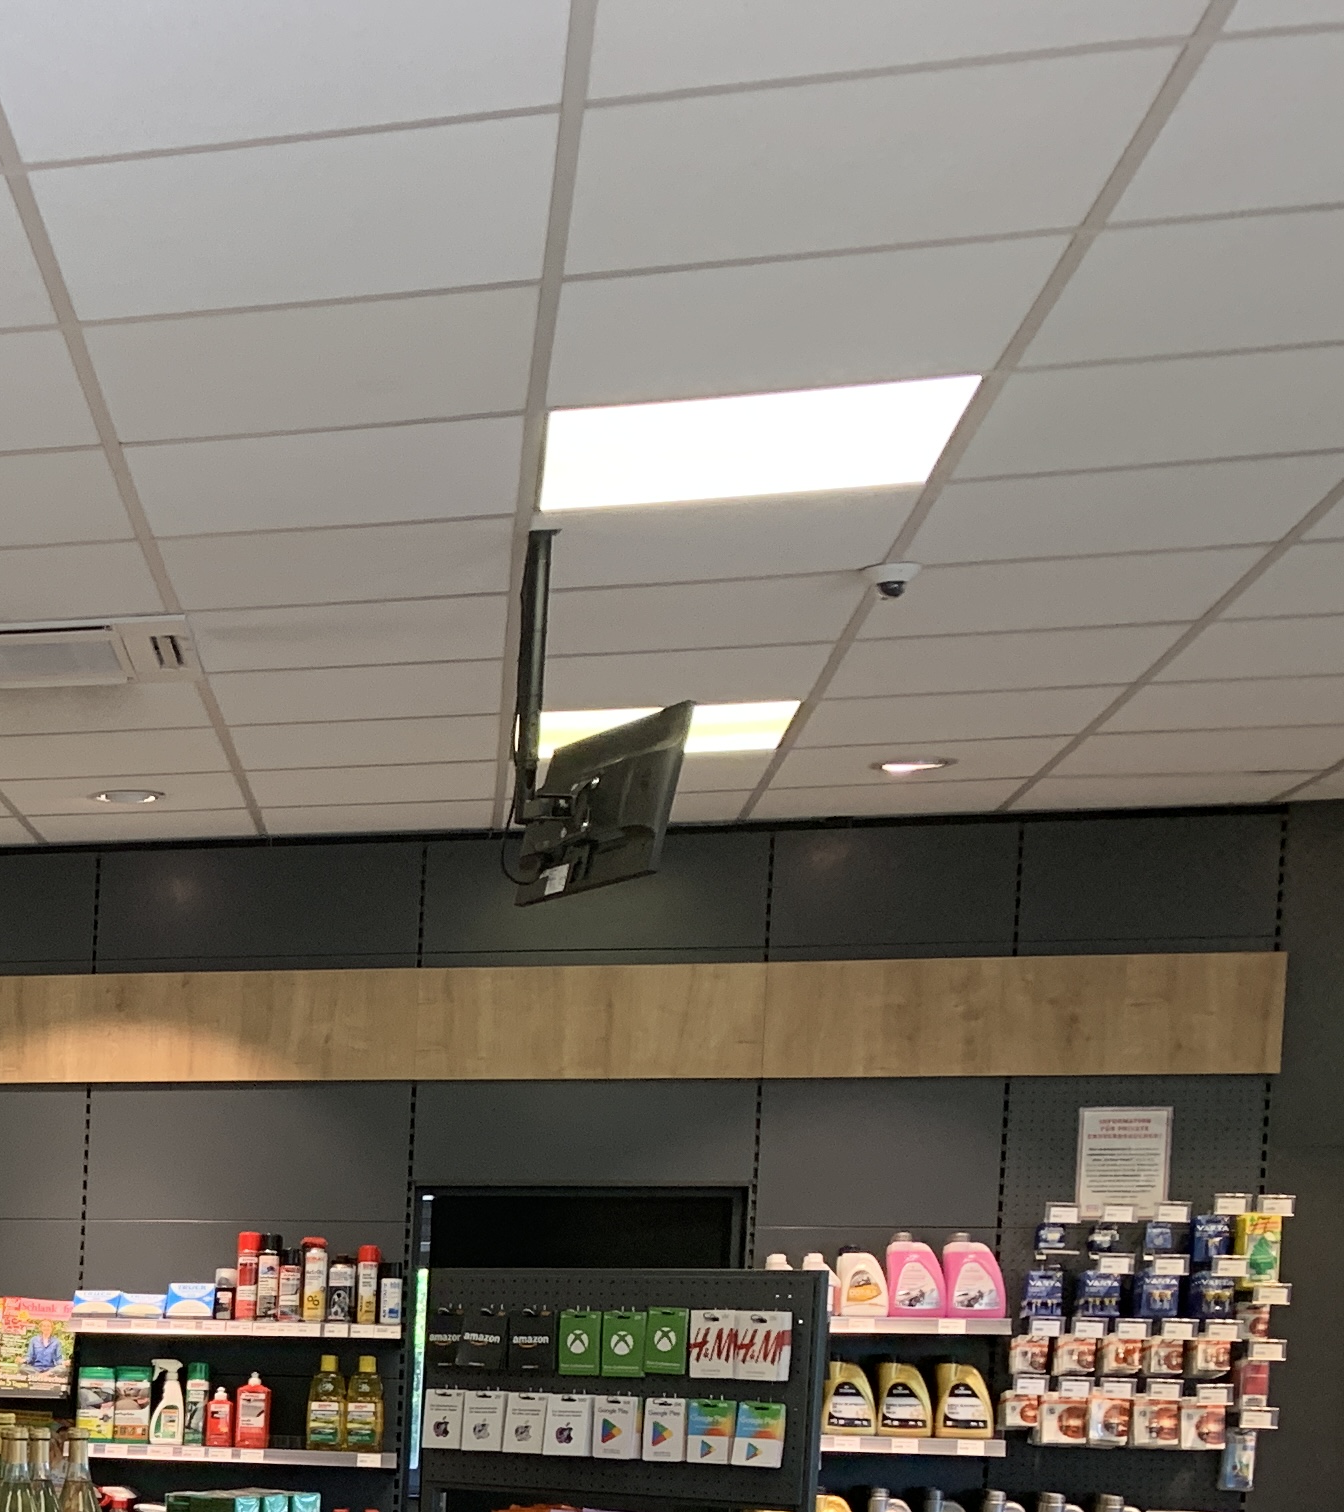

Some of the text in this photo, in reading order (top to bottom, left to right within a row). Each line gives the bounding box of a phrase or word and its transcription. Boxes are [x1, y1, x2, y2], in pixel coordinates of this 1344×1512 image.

[1197, 1225, 1231, 1233] VARTA
[1029, 1279, 1063, 1287] VARTA
[1087, 1279, 1119, 1287] VARTA
[1145, 1277, 1177, 1285] VARTA
[464, 1331, 501, 1344] amazon
[513, 1334, 549, 1344] amazon
[689, 1327, 736, 1364] H&M
[735, 1328, 783, 1366] H&M
